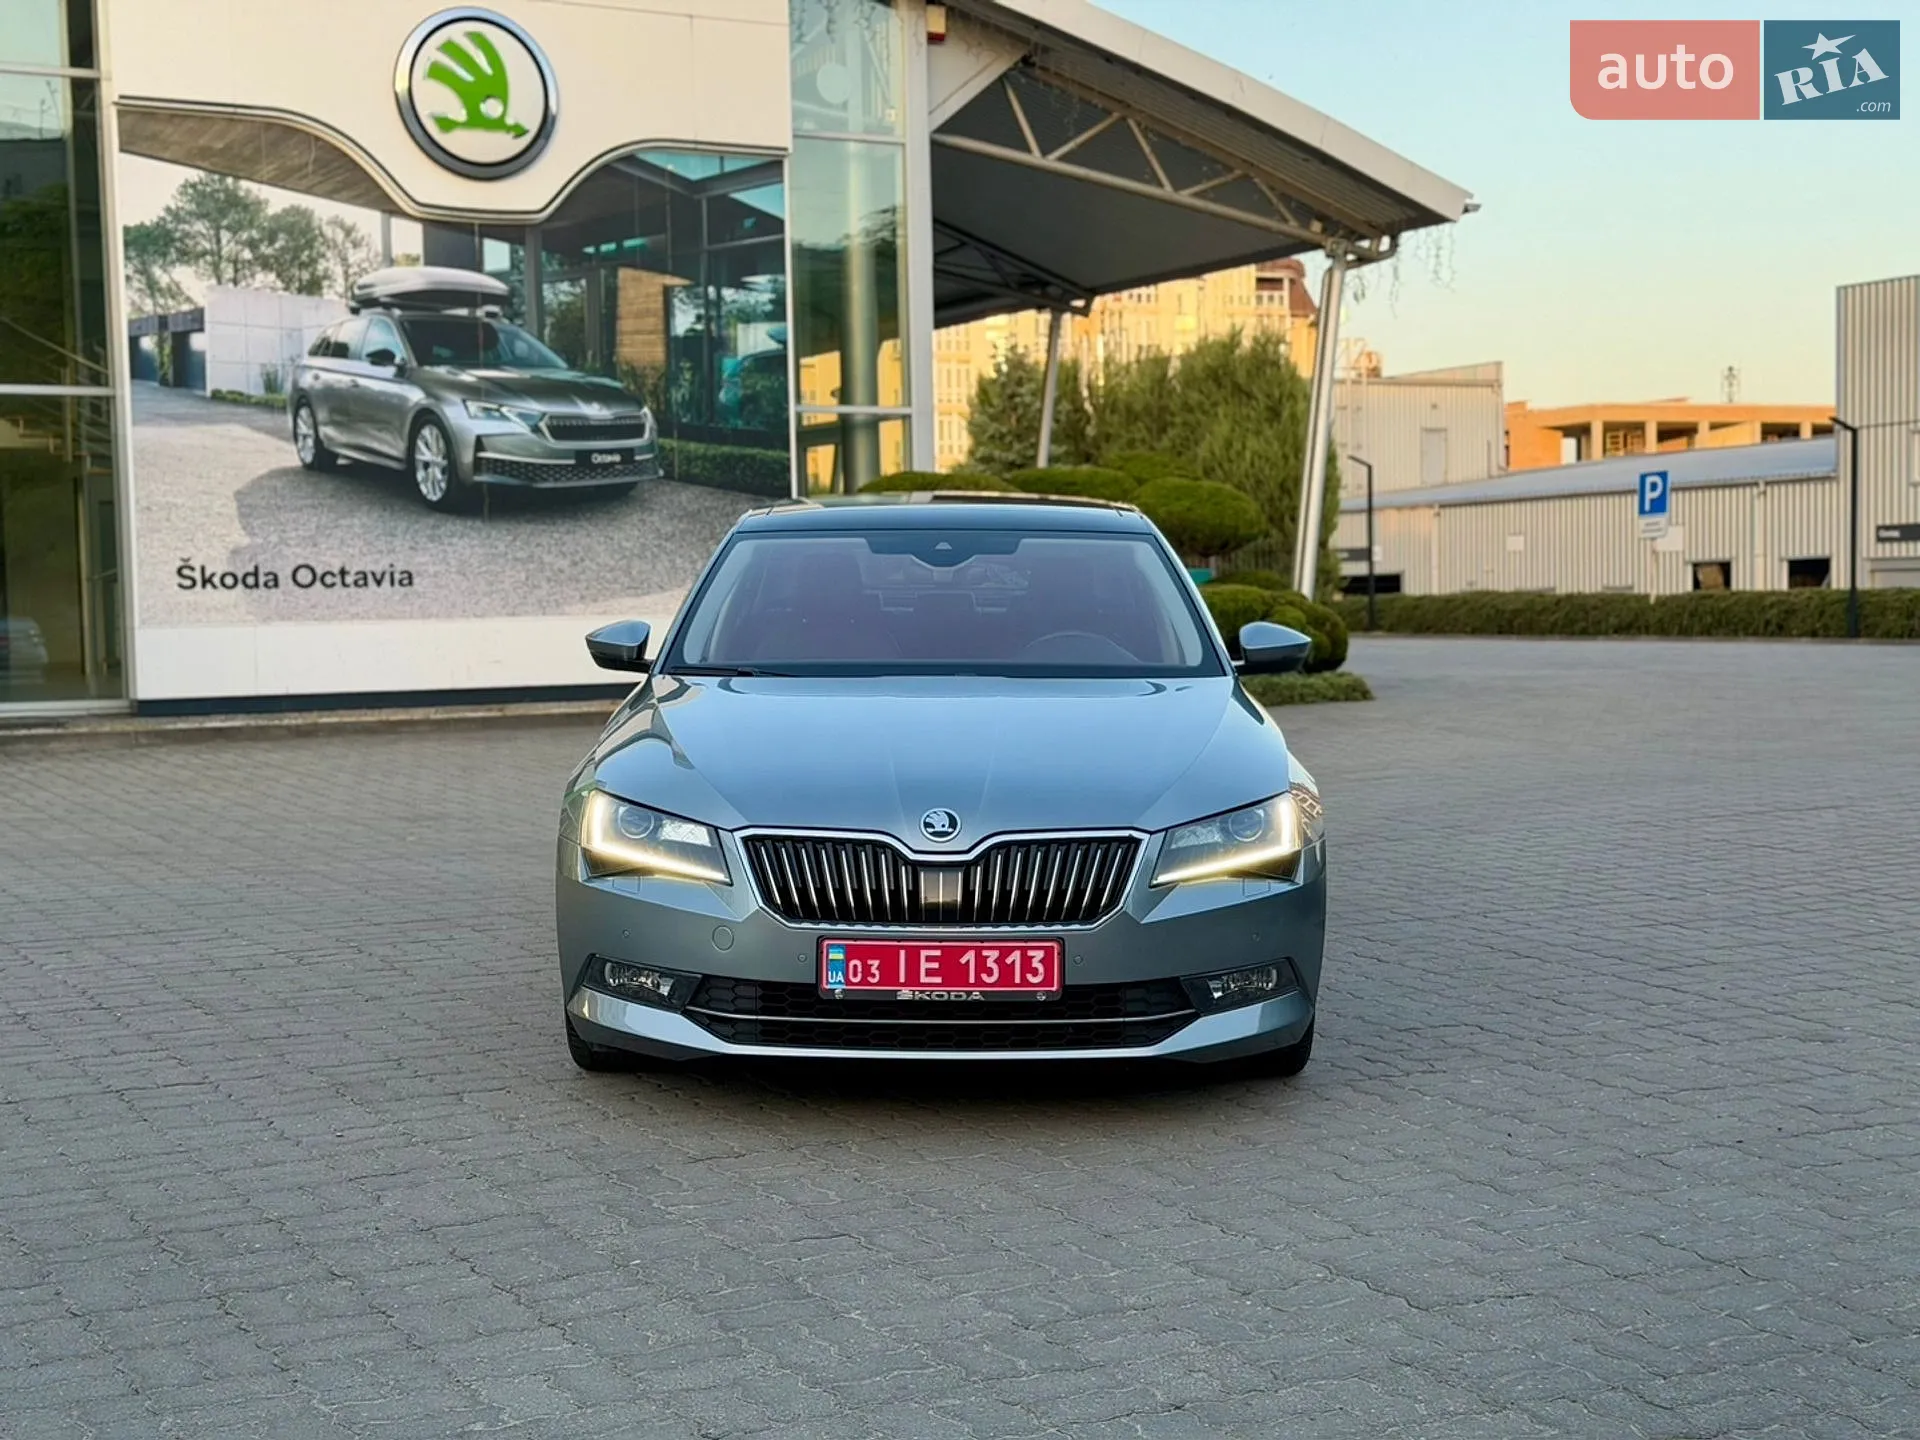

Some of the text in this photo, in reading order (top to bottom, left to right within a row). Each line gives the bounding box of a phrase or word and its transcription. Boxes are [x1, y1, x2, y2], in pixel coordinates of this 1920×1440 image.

[1644, 474, 1664, 512] P
[176, 557, 414, 591] Škoda Octavia
[828, 970, 845, 984] UA
[848, 949, 1046, 984] 03 IE 1313
